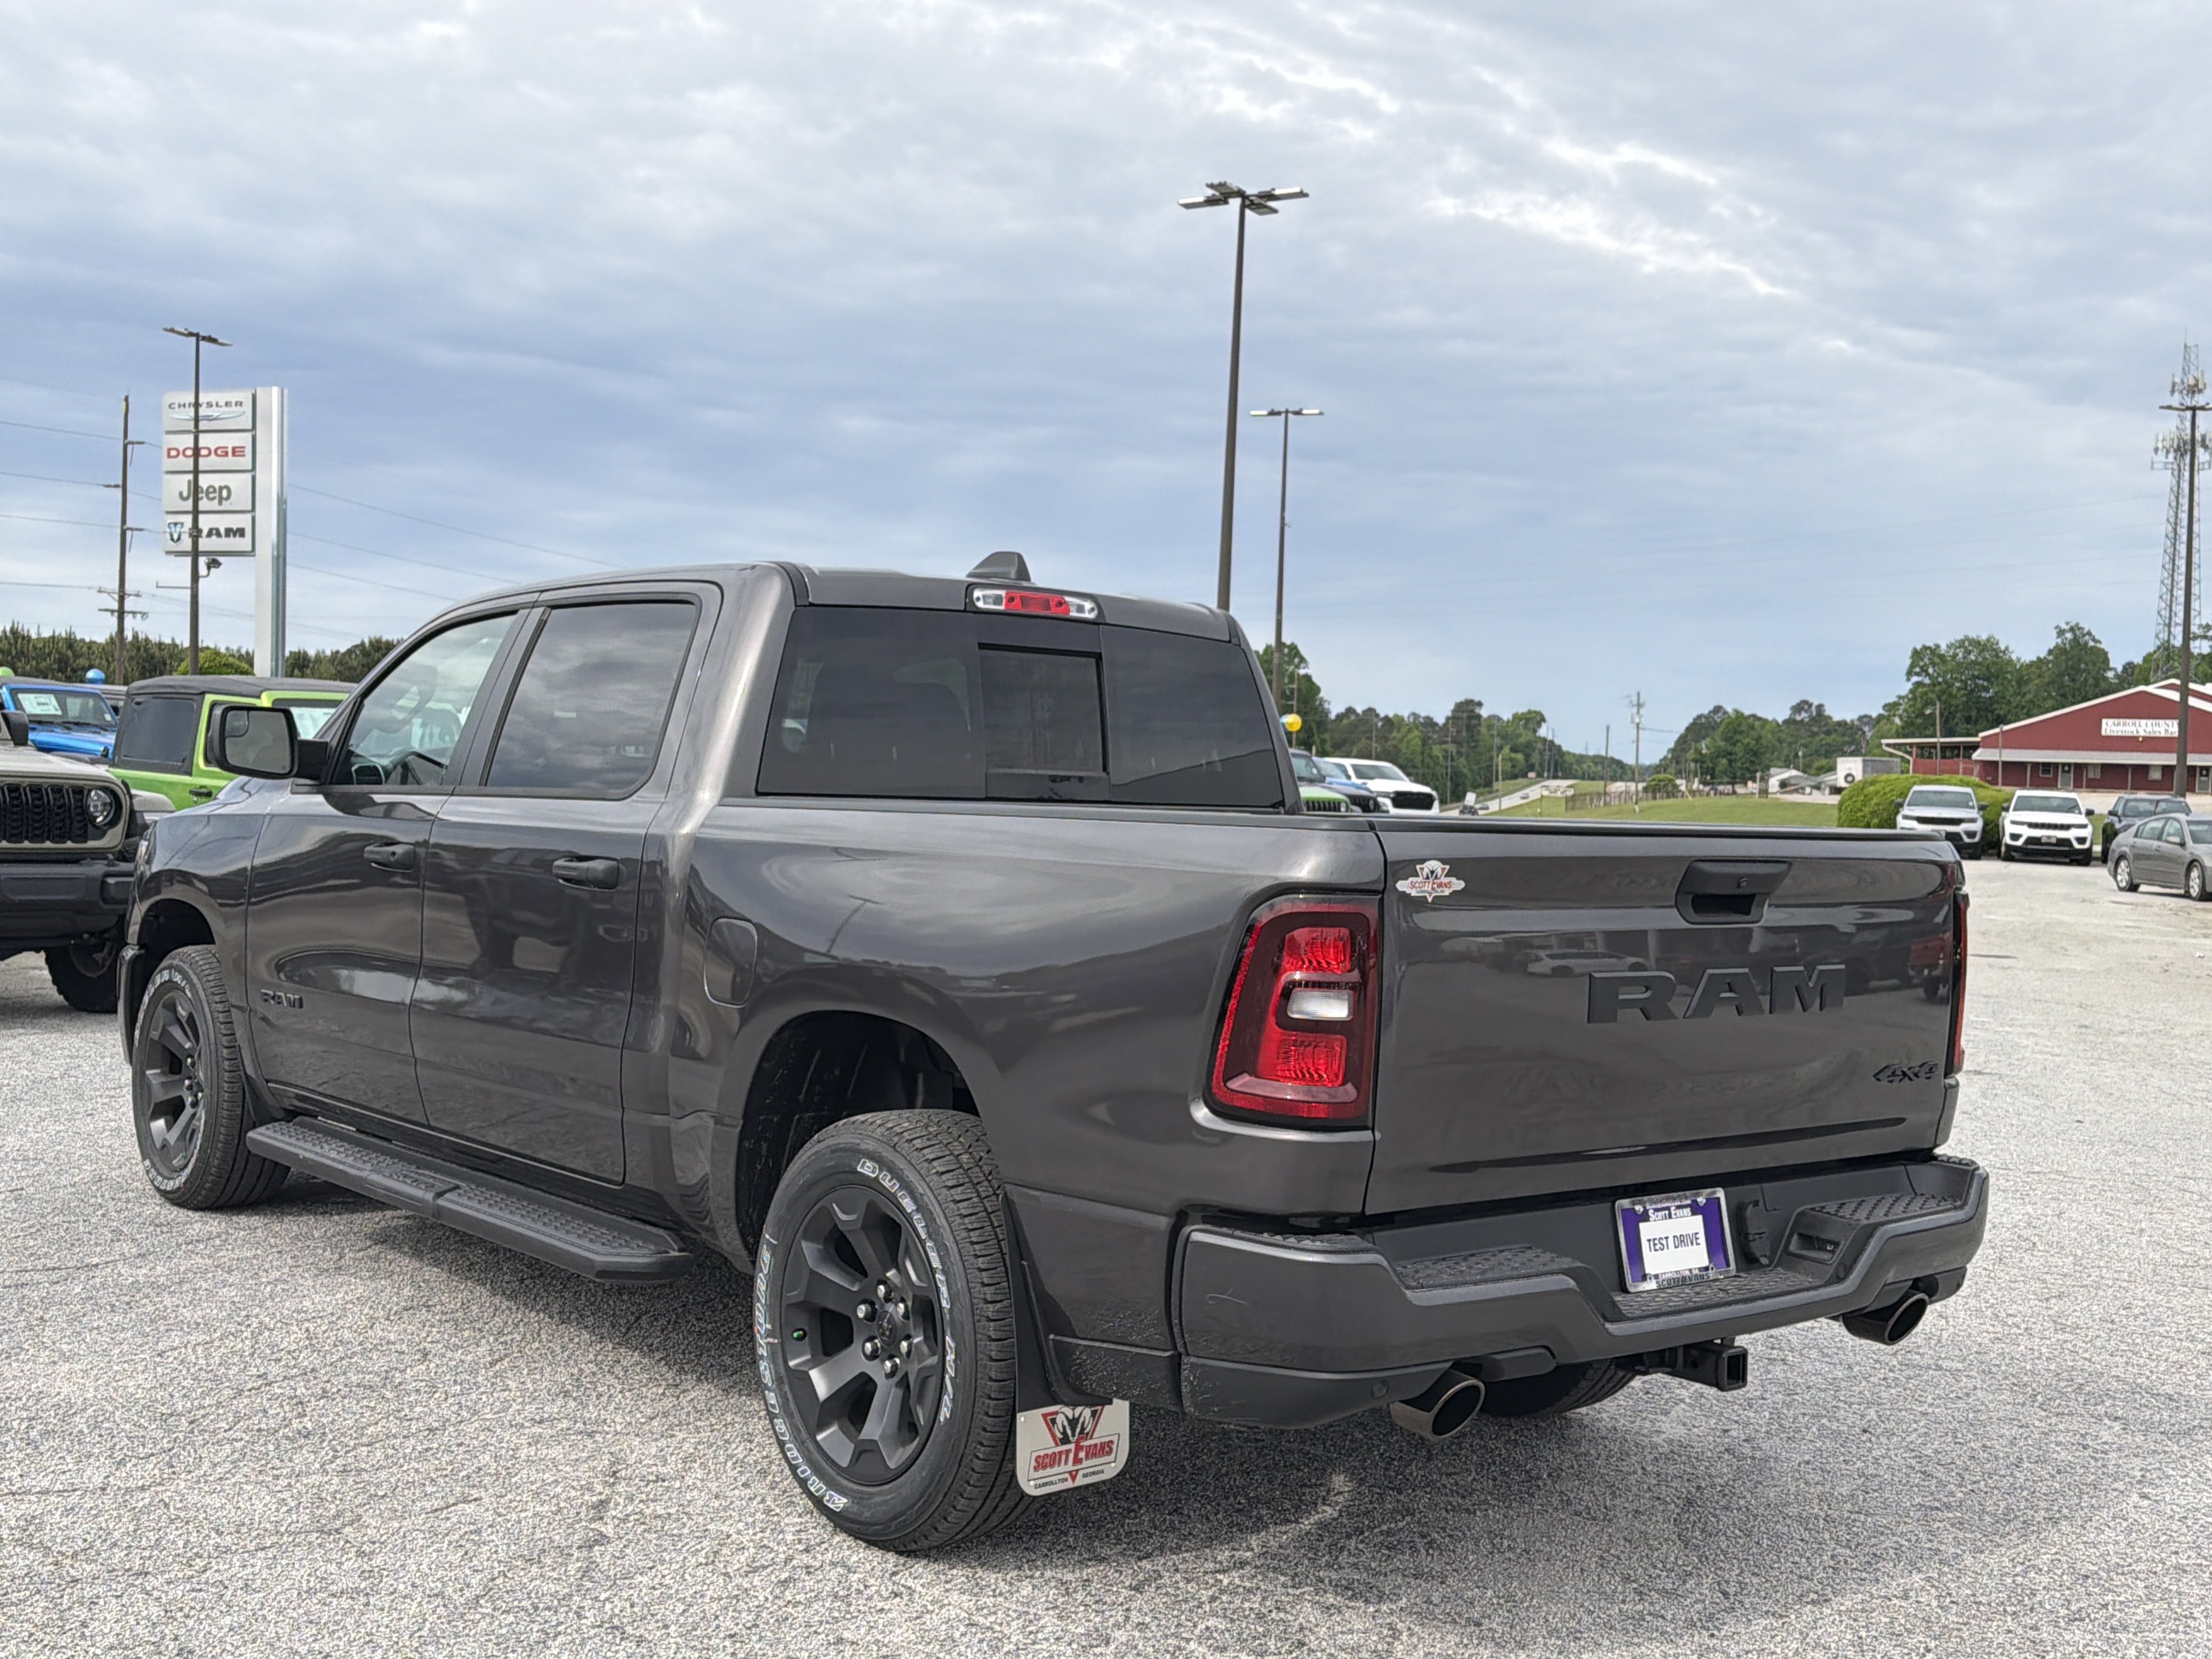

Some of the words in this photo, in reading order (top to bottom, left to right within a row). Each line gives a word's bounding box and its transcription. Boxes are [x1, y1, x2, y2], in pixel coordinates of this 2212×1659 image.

[168, 400, 243, 409] CHRYSLER
[167, 446, 246, 459] DODGE
[178, 479, 232, 506] Jeep
[188, 527, 245, 538] RAM
[1409, 881, 1431, 889] SCOTT
[1587, 964, 1846, 1024] RAM
[1648, 1209, 1669, 1222] SCOTT
[1671, 1206, 1691, 1218] EVANS
[1646, 1236, 1669, 1252] TEST
[1673, 1232, 1701, 1249] DRIVE
[754, 1244, 848, 1513] BRIDGESTONE
[1033, 1448, 1072, 1472] SCOTT
[1072, 1434, 1114, 1466] EVANS
[1034, 1477, 1068, 1489] CARROLLTON
[1082, 1469, 1105, 1478] GEORGIA
